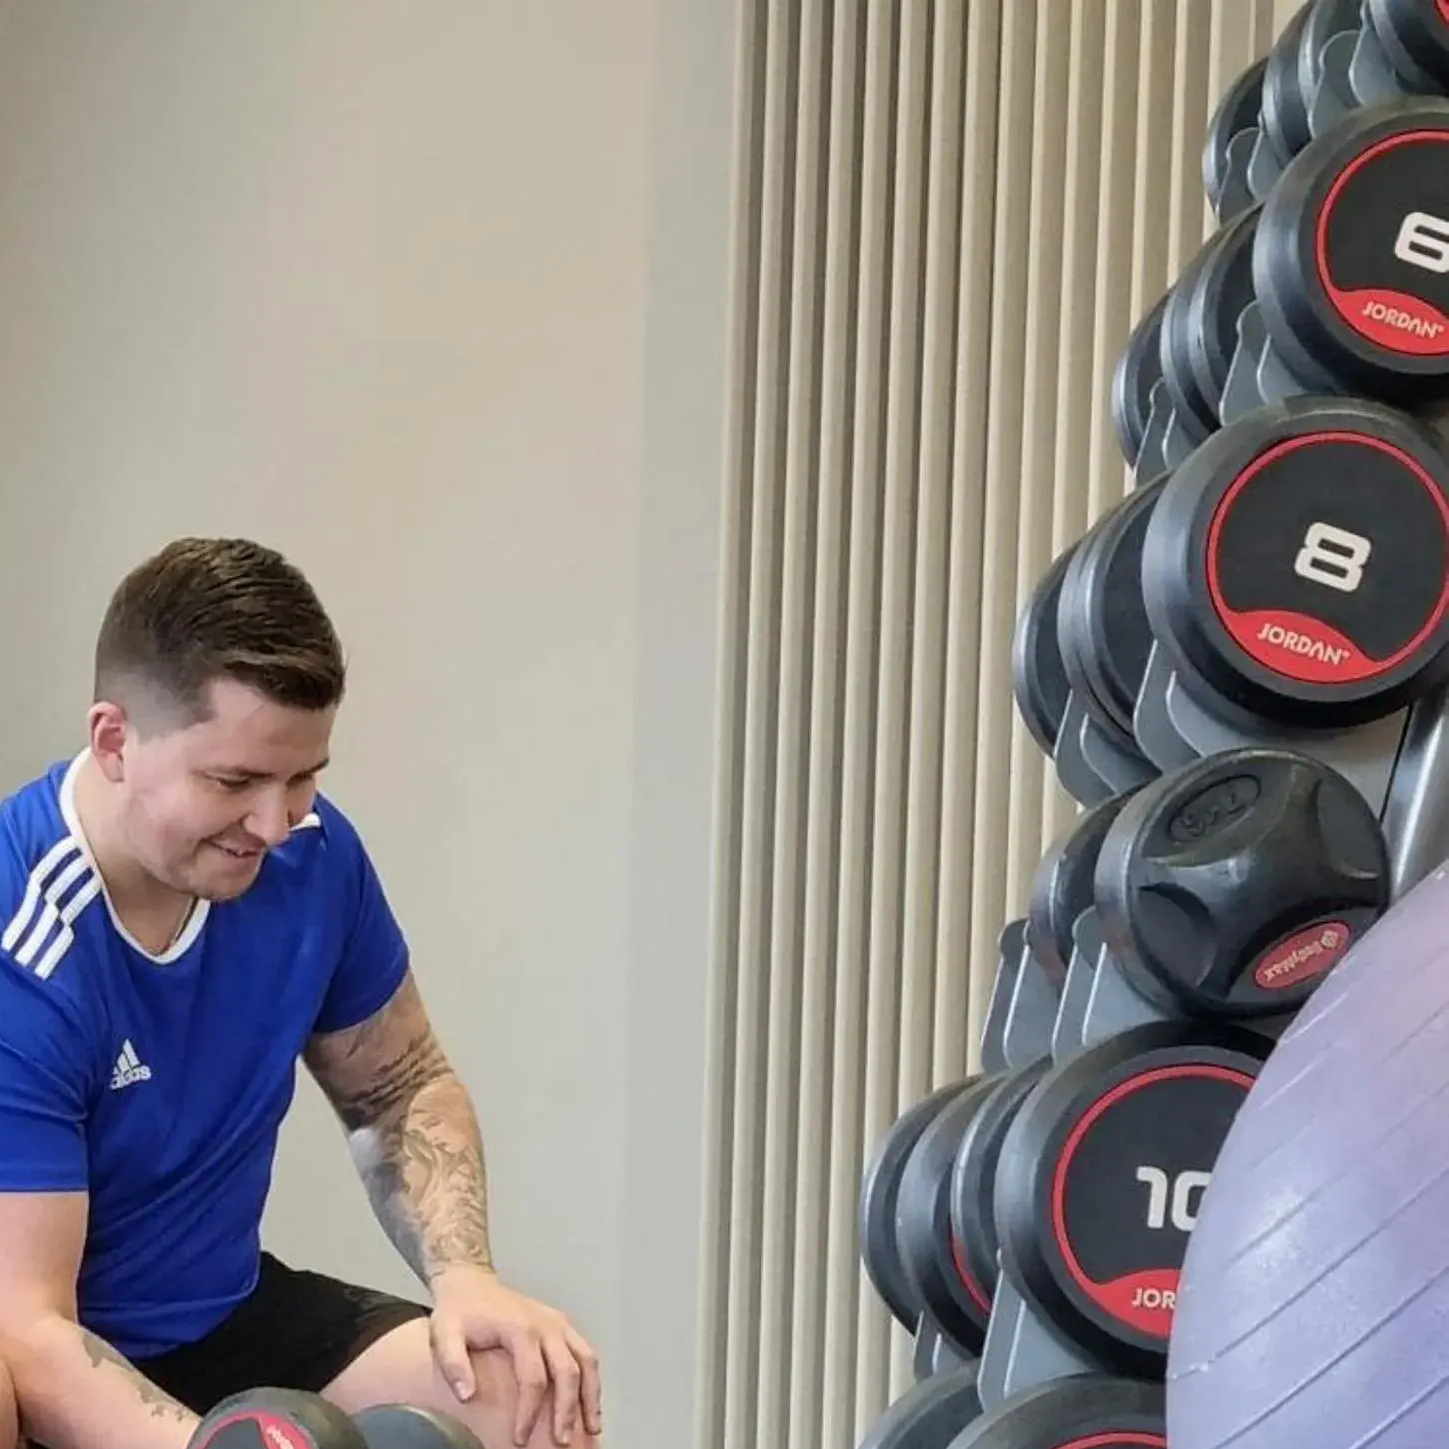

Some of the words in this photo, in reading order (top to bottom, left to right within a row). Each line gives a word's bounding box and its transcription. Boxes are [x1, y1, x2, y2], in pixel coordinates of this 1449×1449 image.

[1395, 211, 1449, 273] 6
[1362, 300, 1440, 339] JORDAN
[1294, 522, 1371, 592] 8
[1257, 623, 1343, 666] JORDAN
